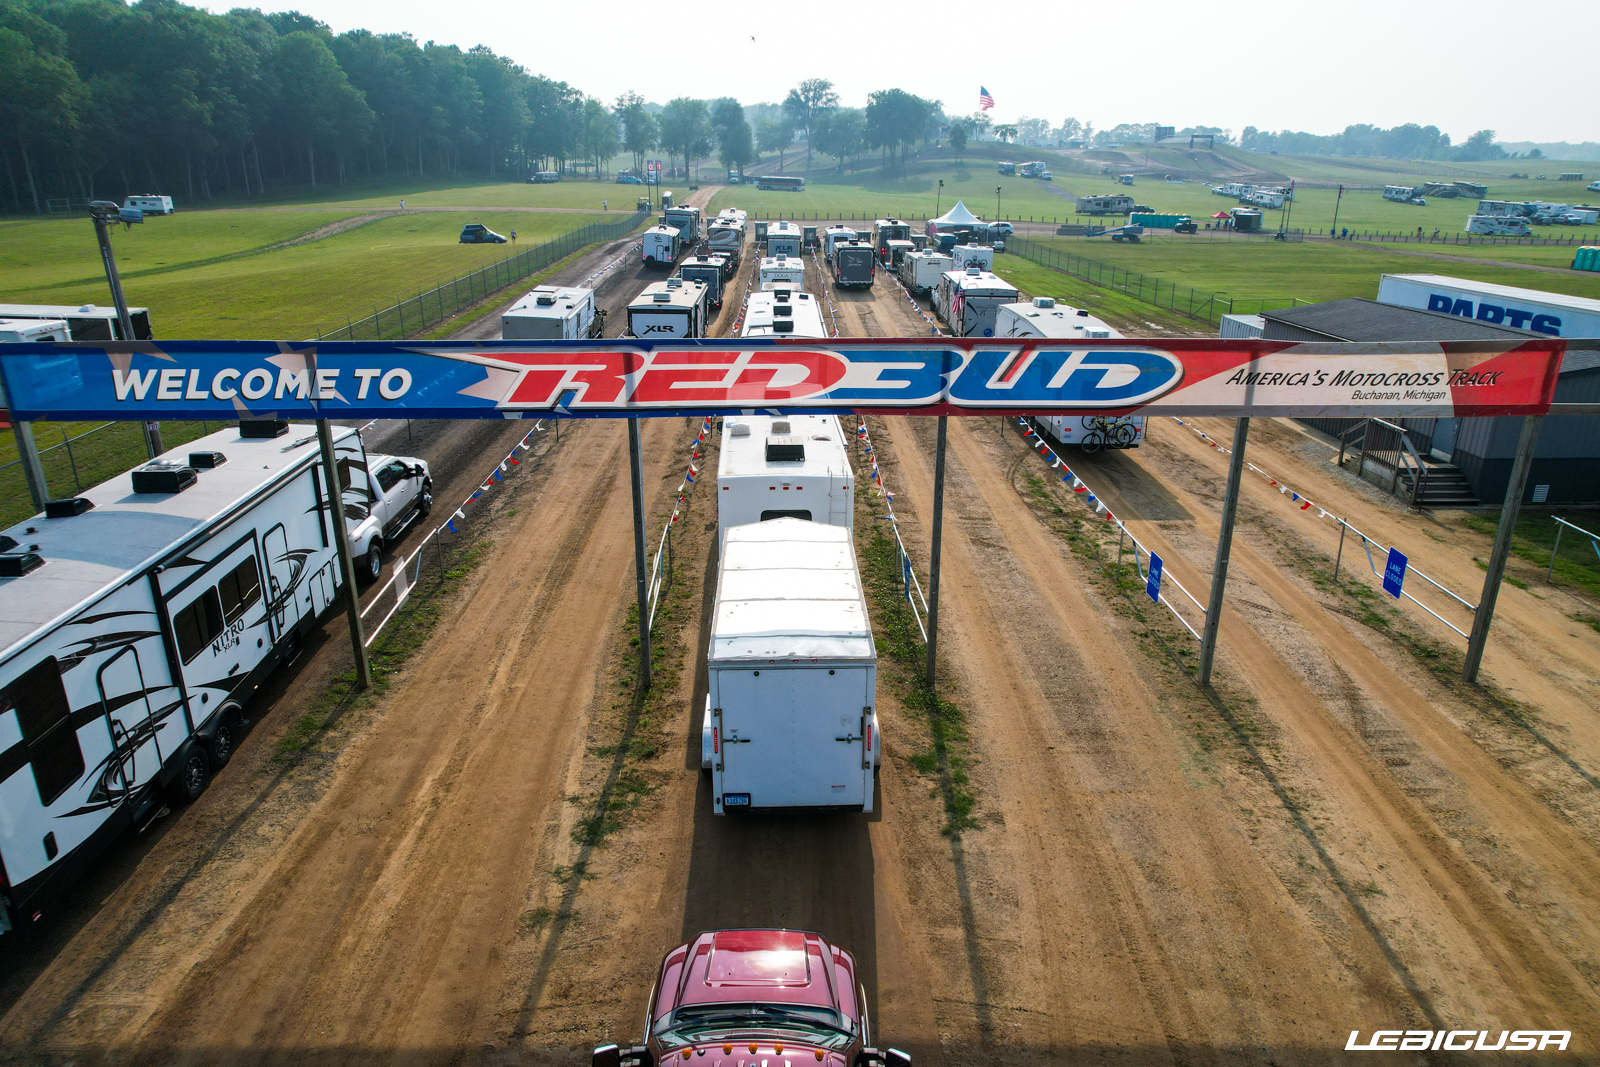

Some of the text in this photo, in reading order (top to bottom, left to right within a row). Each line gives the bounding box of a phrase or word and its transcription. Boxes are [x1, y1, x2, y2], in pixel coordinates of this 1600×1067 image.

[642, 324, 674, 335] XLR
[112, 367, 413, 401] WELCOME TO
[1225, 368, 1504, 387] AMERICA'S MOTOCROSS TRACK
[1351, 389, 1447, 401] Buchanan, Michigan
[1389, 561, 1401, 575] LANE
[1385, 569, 1402, 586] CLOSED
[211, 618, 245, 659] NITRO
